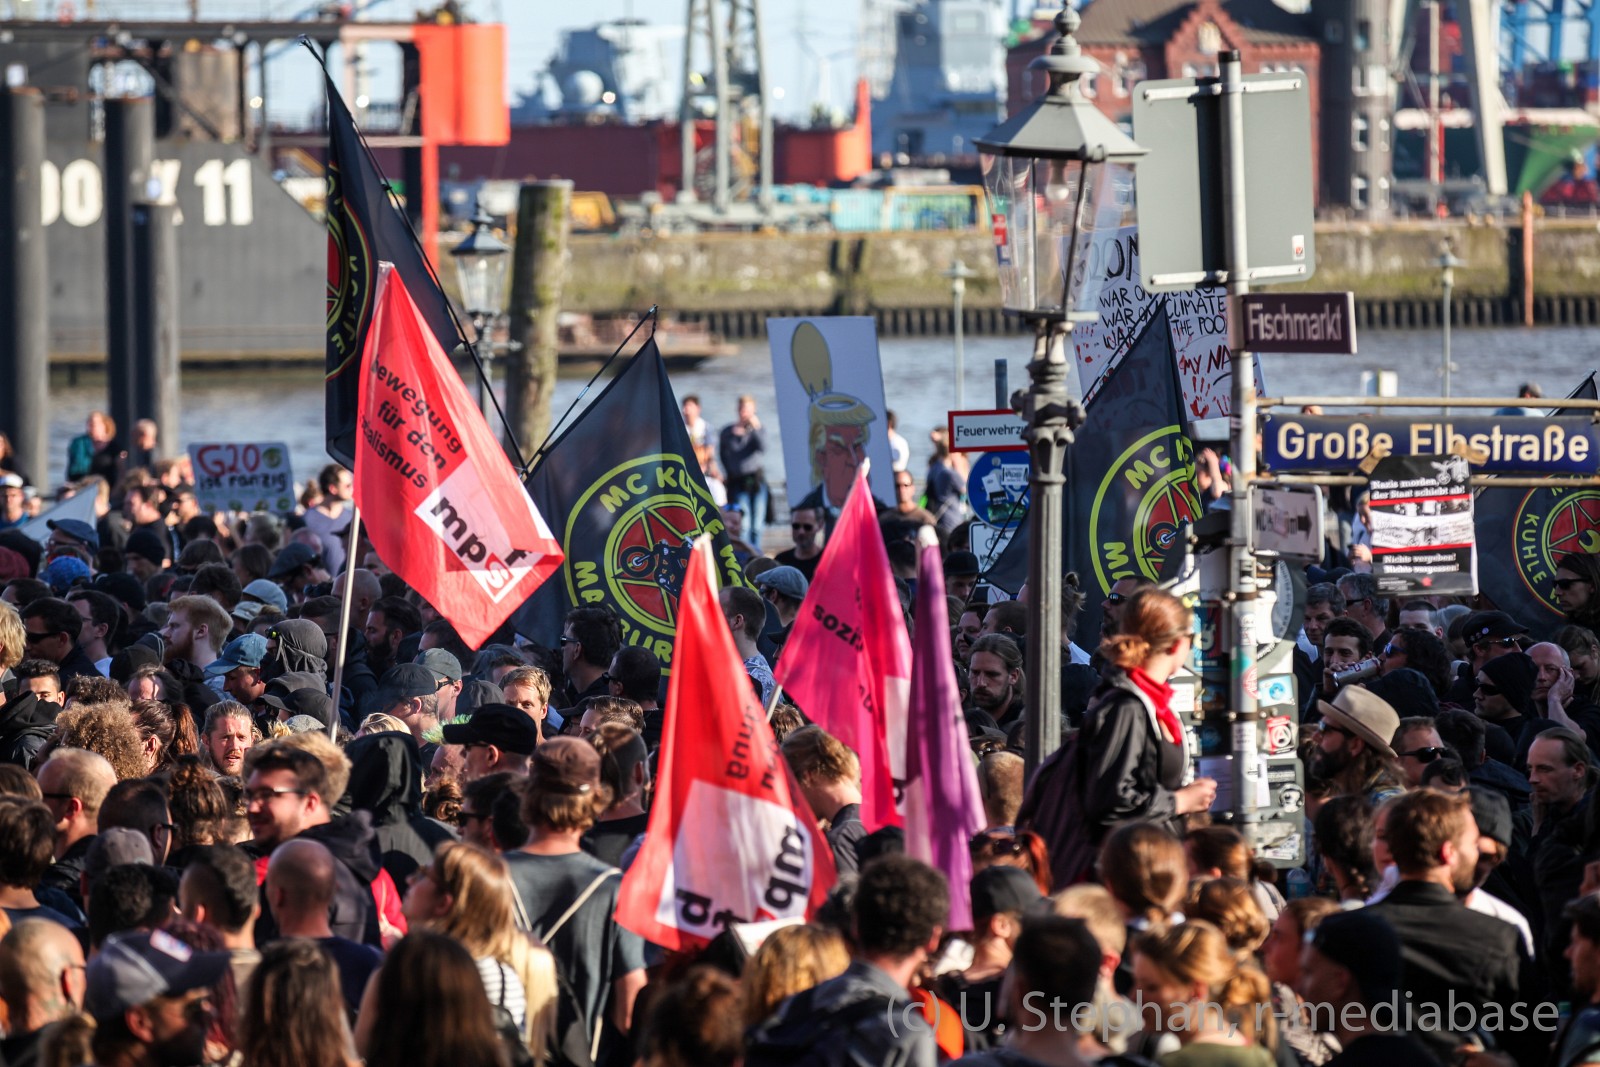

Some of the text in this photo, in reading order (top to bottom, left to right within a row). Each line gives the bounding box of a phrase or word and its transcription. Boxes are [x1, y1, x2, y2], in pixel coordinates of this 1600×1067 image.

[194, 158, 253, 226] 11
[1099, 288, 1132, 309] WAR
[1101, 308, 1137, 328] WAR
[1165, 294, 1228, 319] CLIMATE
[1198, 314, 1227, 335] POO
[1249, 303, 1342, 342] Fischmarkt
[377, 400, 406, 430] für
[1278, 422, 1393, 460] Große
[197, 444, 260, 477] G20
[1125, 445, 1171, 490] MC
[601, 473, 648, 513] MC
[1521, 513, 1547, 584] KUHLE
